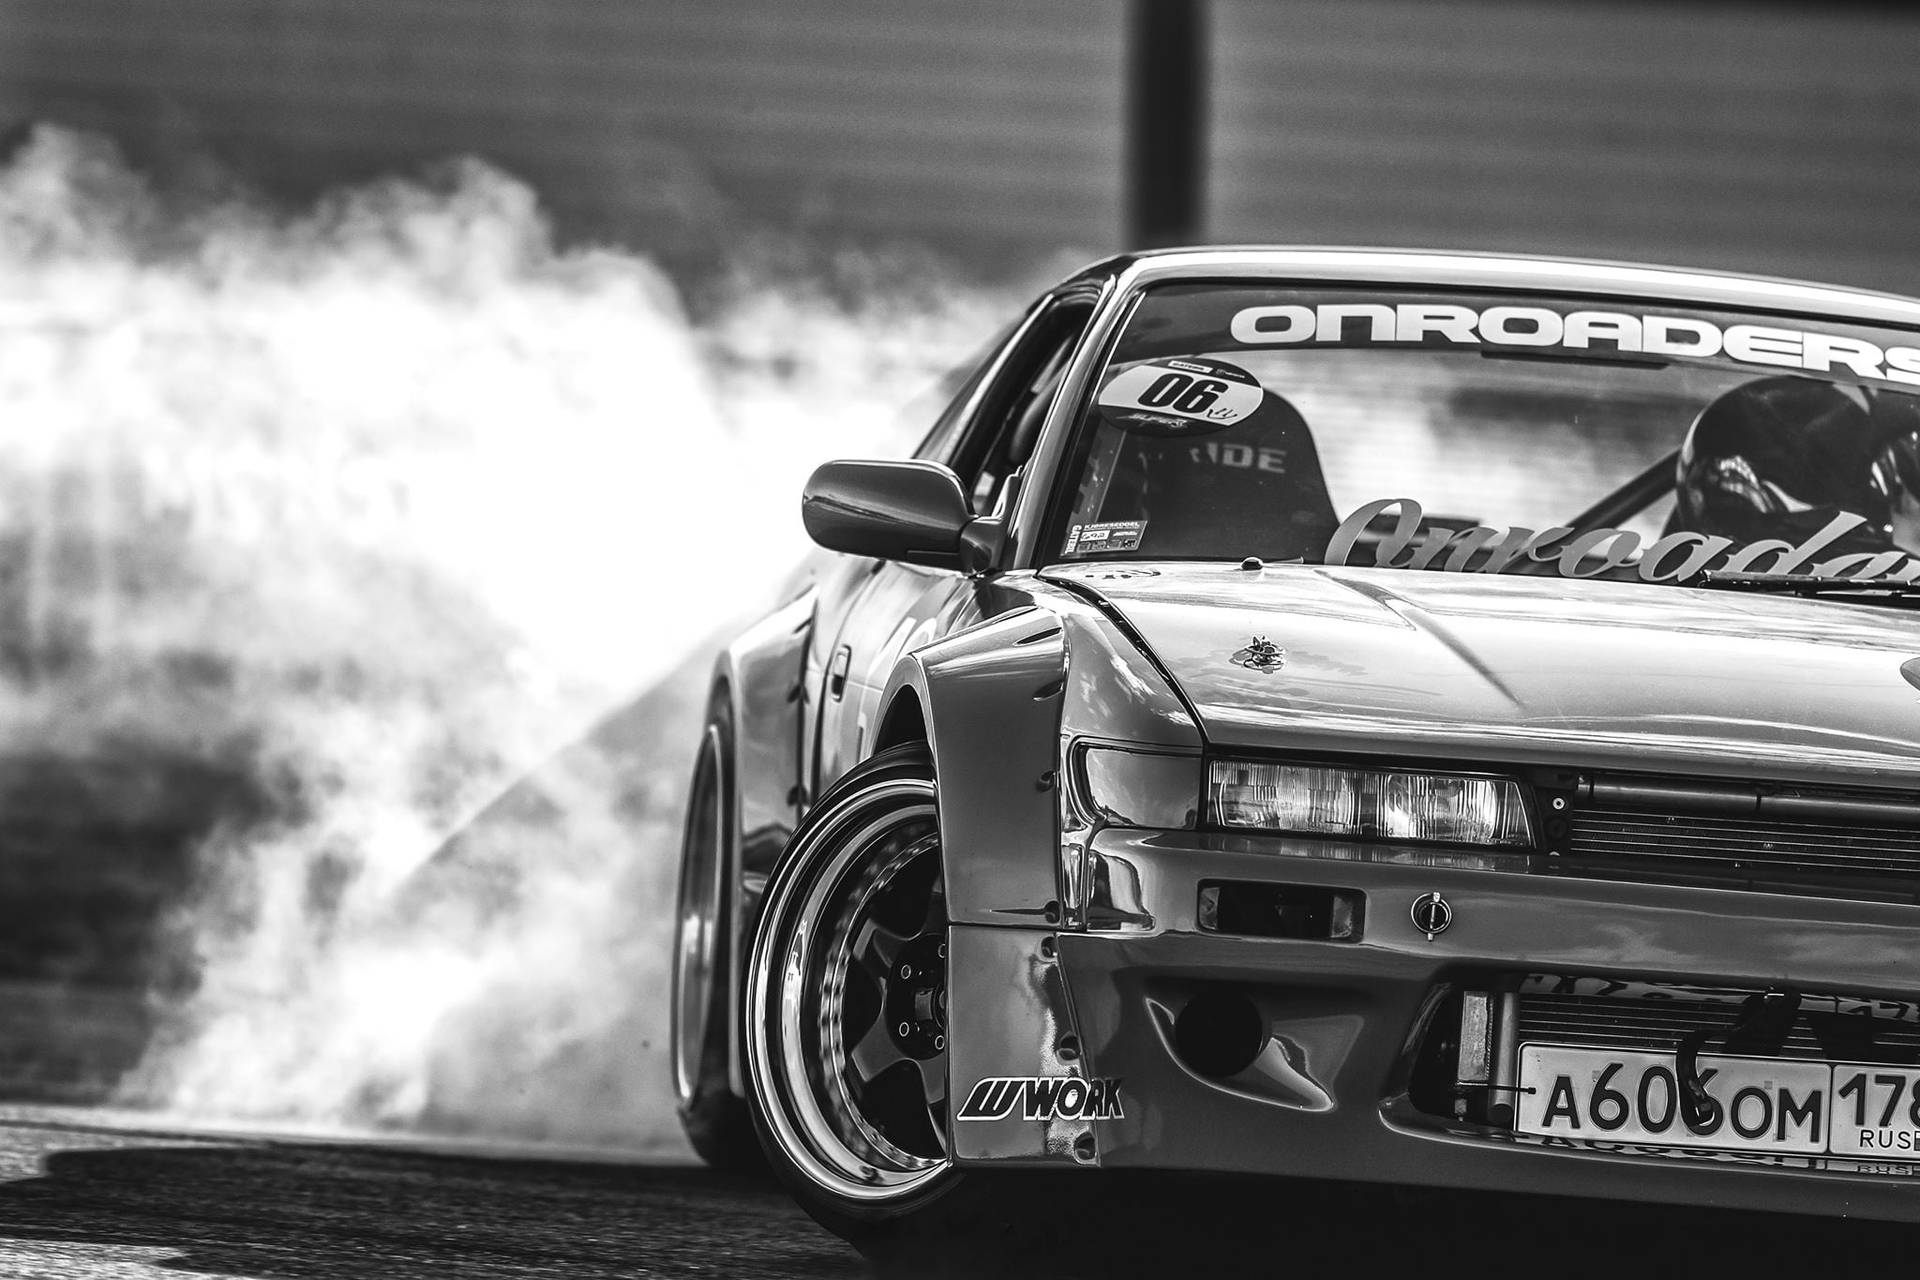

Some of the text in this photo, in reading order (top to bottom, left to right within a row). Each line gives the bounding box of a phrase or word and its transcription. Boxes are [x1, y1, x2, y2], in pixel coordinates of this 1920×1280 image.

[1137, 372, 1229, 414] 06
[1023, 1077, 1125, 1121] WORK
[1859, 1129, 1911, 1150] RUS
